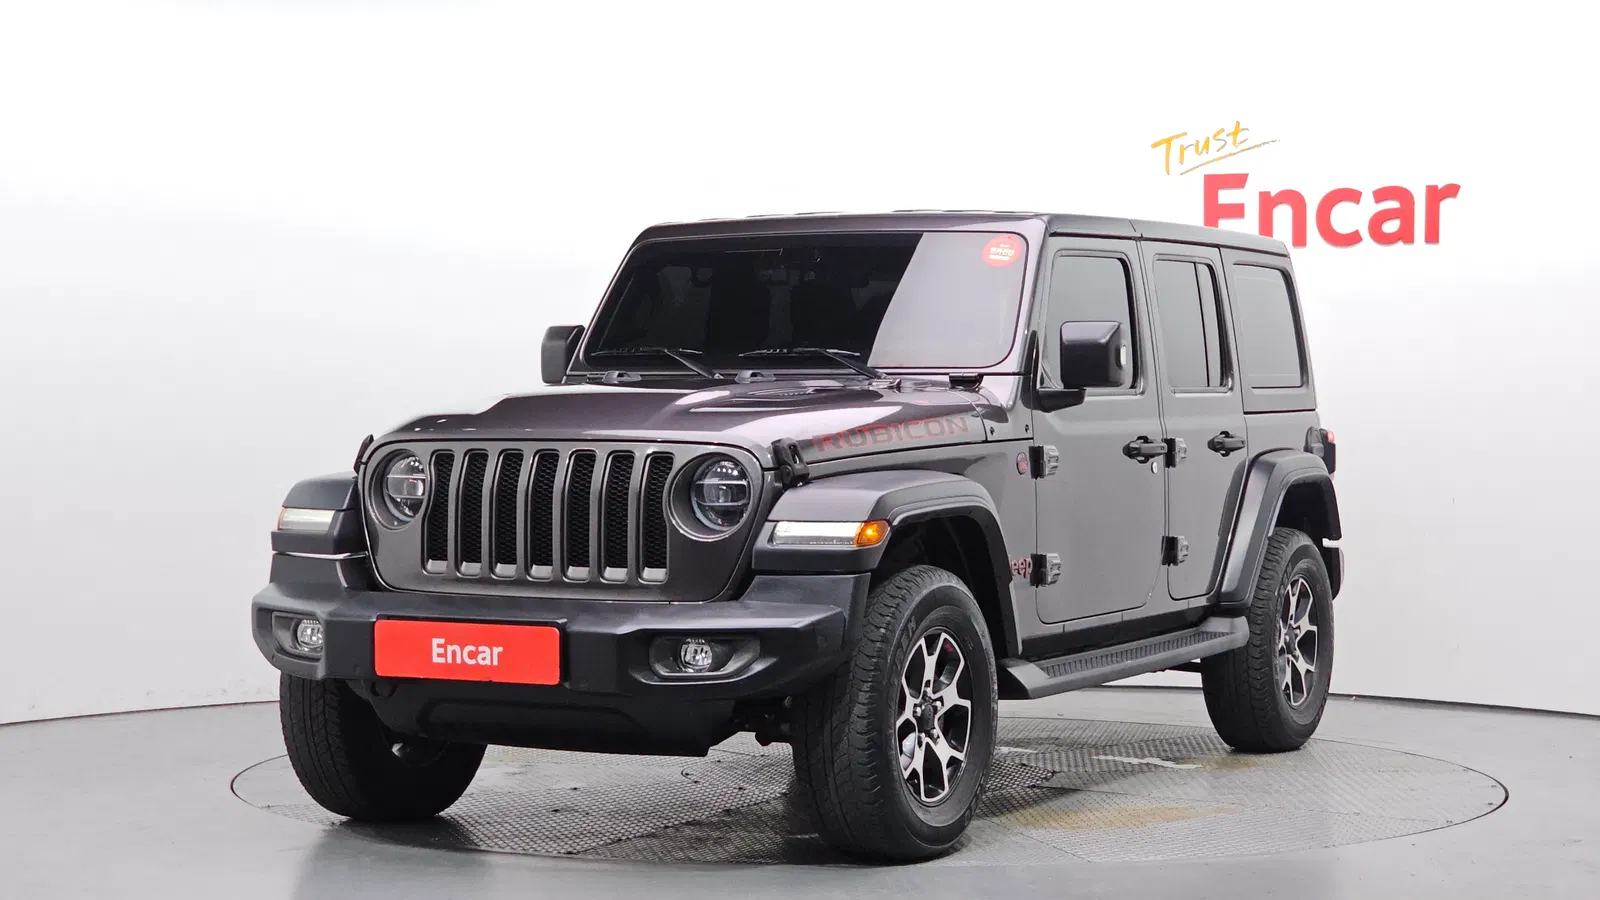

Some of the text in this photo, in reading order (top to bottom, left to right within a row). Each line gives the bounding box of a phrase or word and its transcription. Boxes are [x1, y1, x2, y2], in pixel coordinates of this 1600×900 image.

[1151, 120, 1249, 175] Trust
[1203, 172, 1462, 248] Encar
[812, 416, 970, 453] RUBICON
[1010, 557, 1033, 579] eep
[431, 637, 504, 667] Encar
